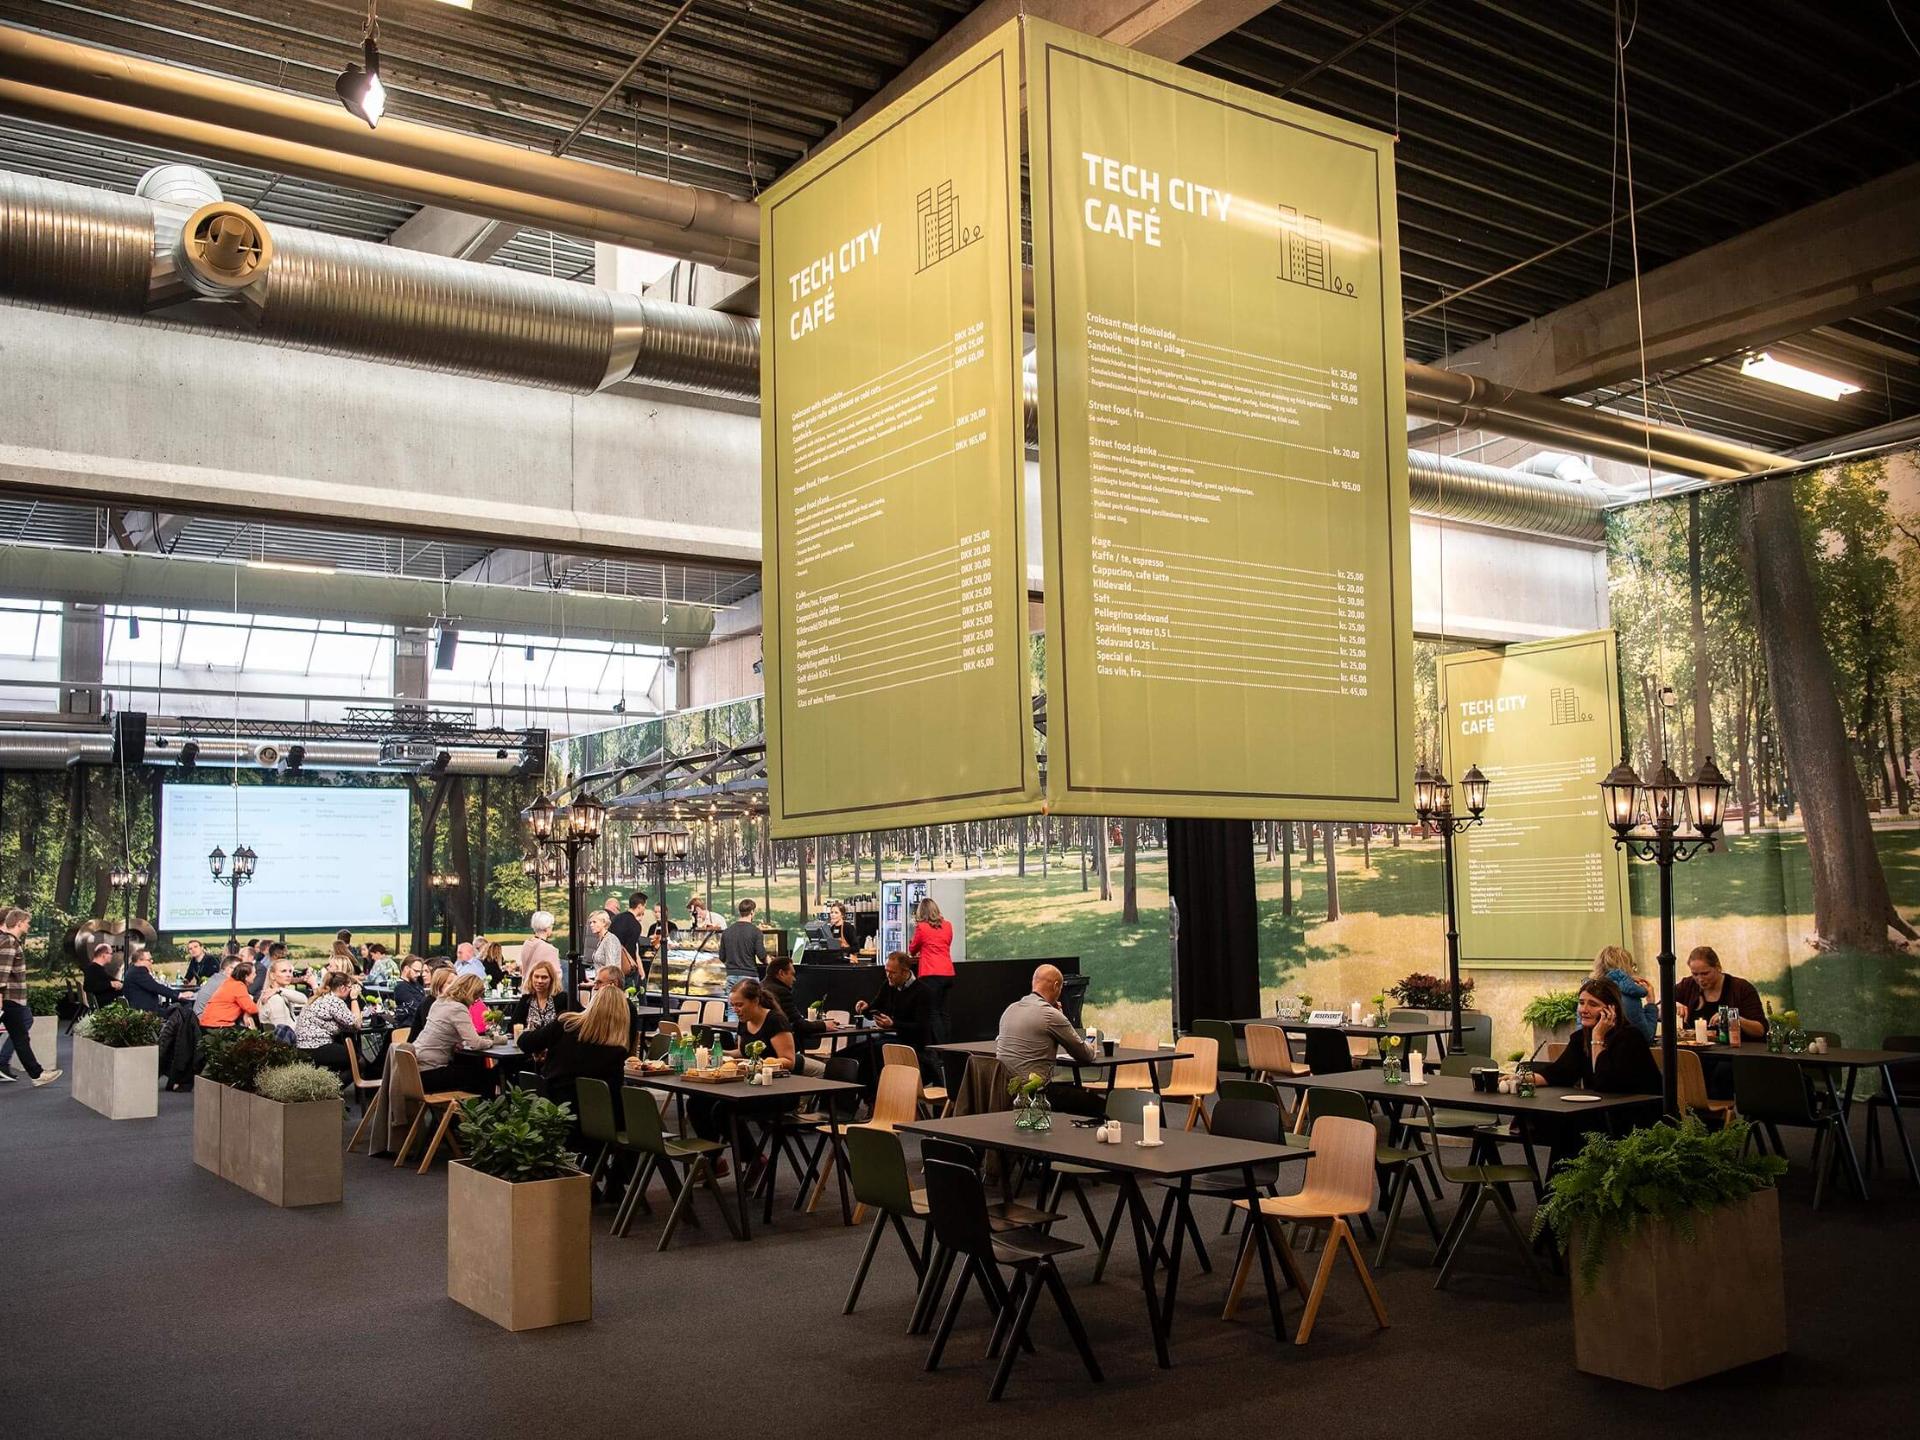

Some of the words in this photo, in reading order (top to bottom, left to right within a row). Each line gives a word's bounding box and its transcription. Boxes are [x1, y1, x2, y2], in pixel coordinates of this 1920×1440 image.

[1082, 152, 1160, 203] TECH
[1169, 178, 1233, 221] CITY
[1085, 198, 1161, 247] CAFÉ
[789, 252, 834, 302] TECH
[839, 224, 881, 273] CITY
[790, 286, 835, 340] CAFÉ
[1087, 312, 1121, 328] Croissant
[1122, 322, 1138, 332] med
[1139, 325, 1176, 340] chokolade
[1087, 326, 1122, 341] Grovbolle
[1123, 336, 1139, 345] med
[1141, 340, 1152, 348] ost
[1164, 344, 1185, 357] pålæg
[1088, 340, 1122, 355] Sandwich
[1089, 400, 1111, 412] Street
[1113, 404, 1132, 417] food,
[1133, 408, 1144, 418] fra
[1089, 436, 1112, 448] Street
[1114, 440, 1131, 451] food
[1132, 445, 1157, 456] planke
[1092, 536, 1111, 548] Kage
[1092, 550, 1113, 561] Kaffe
[1121, 555, 1131, 564] te,
[1133, 557, 1164, 567] espresso
[1092, 564, 1134, 579] Cappucino,
[1136, 570, 1151, 580] cafe
[1152, 572, 1169, 582] latte
[1093, 579, 1131, 591] Kildevæld
[1094, 593, 1110, 603] Saft
[1095, 608, 1133, 620] Pellegrino
[1134, 613, 1169, 623] sodavand
[1095, 622, 1131, 636] Sparkling
[1133, 627, 1153, 636] water
[1154, 628, 1166, 638] 0,5
[1096, 636, 1133, 648] Sodavand
[1134, 640, 1150, 650] 0,25
[1097, 650, 1123, 661] Special
[1097, 665, 1113, 675] Glas
[1114, 667, 1129, 677] vin,
[1130, 668, 1141, 677] fra
[1460, 699, 1494, 717] TECH
[1497, 694, 1528, 713] CITY
[1461, 715, 1495, 736] CAFÉ
[169, 908, 233, 916] FOODTEC
